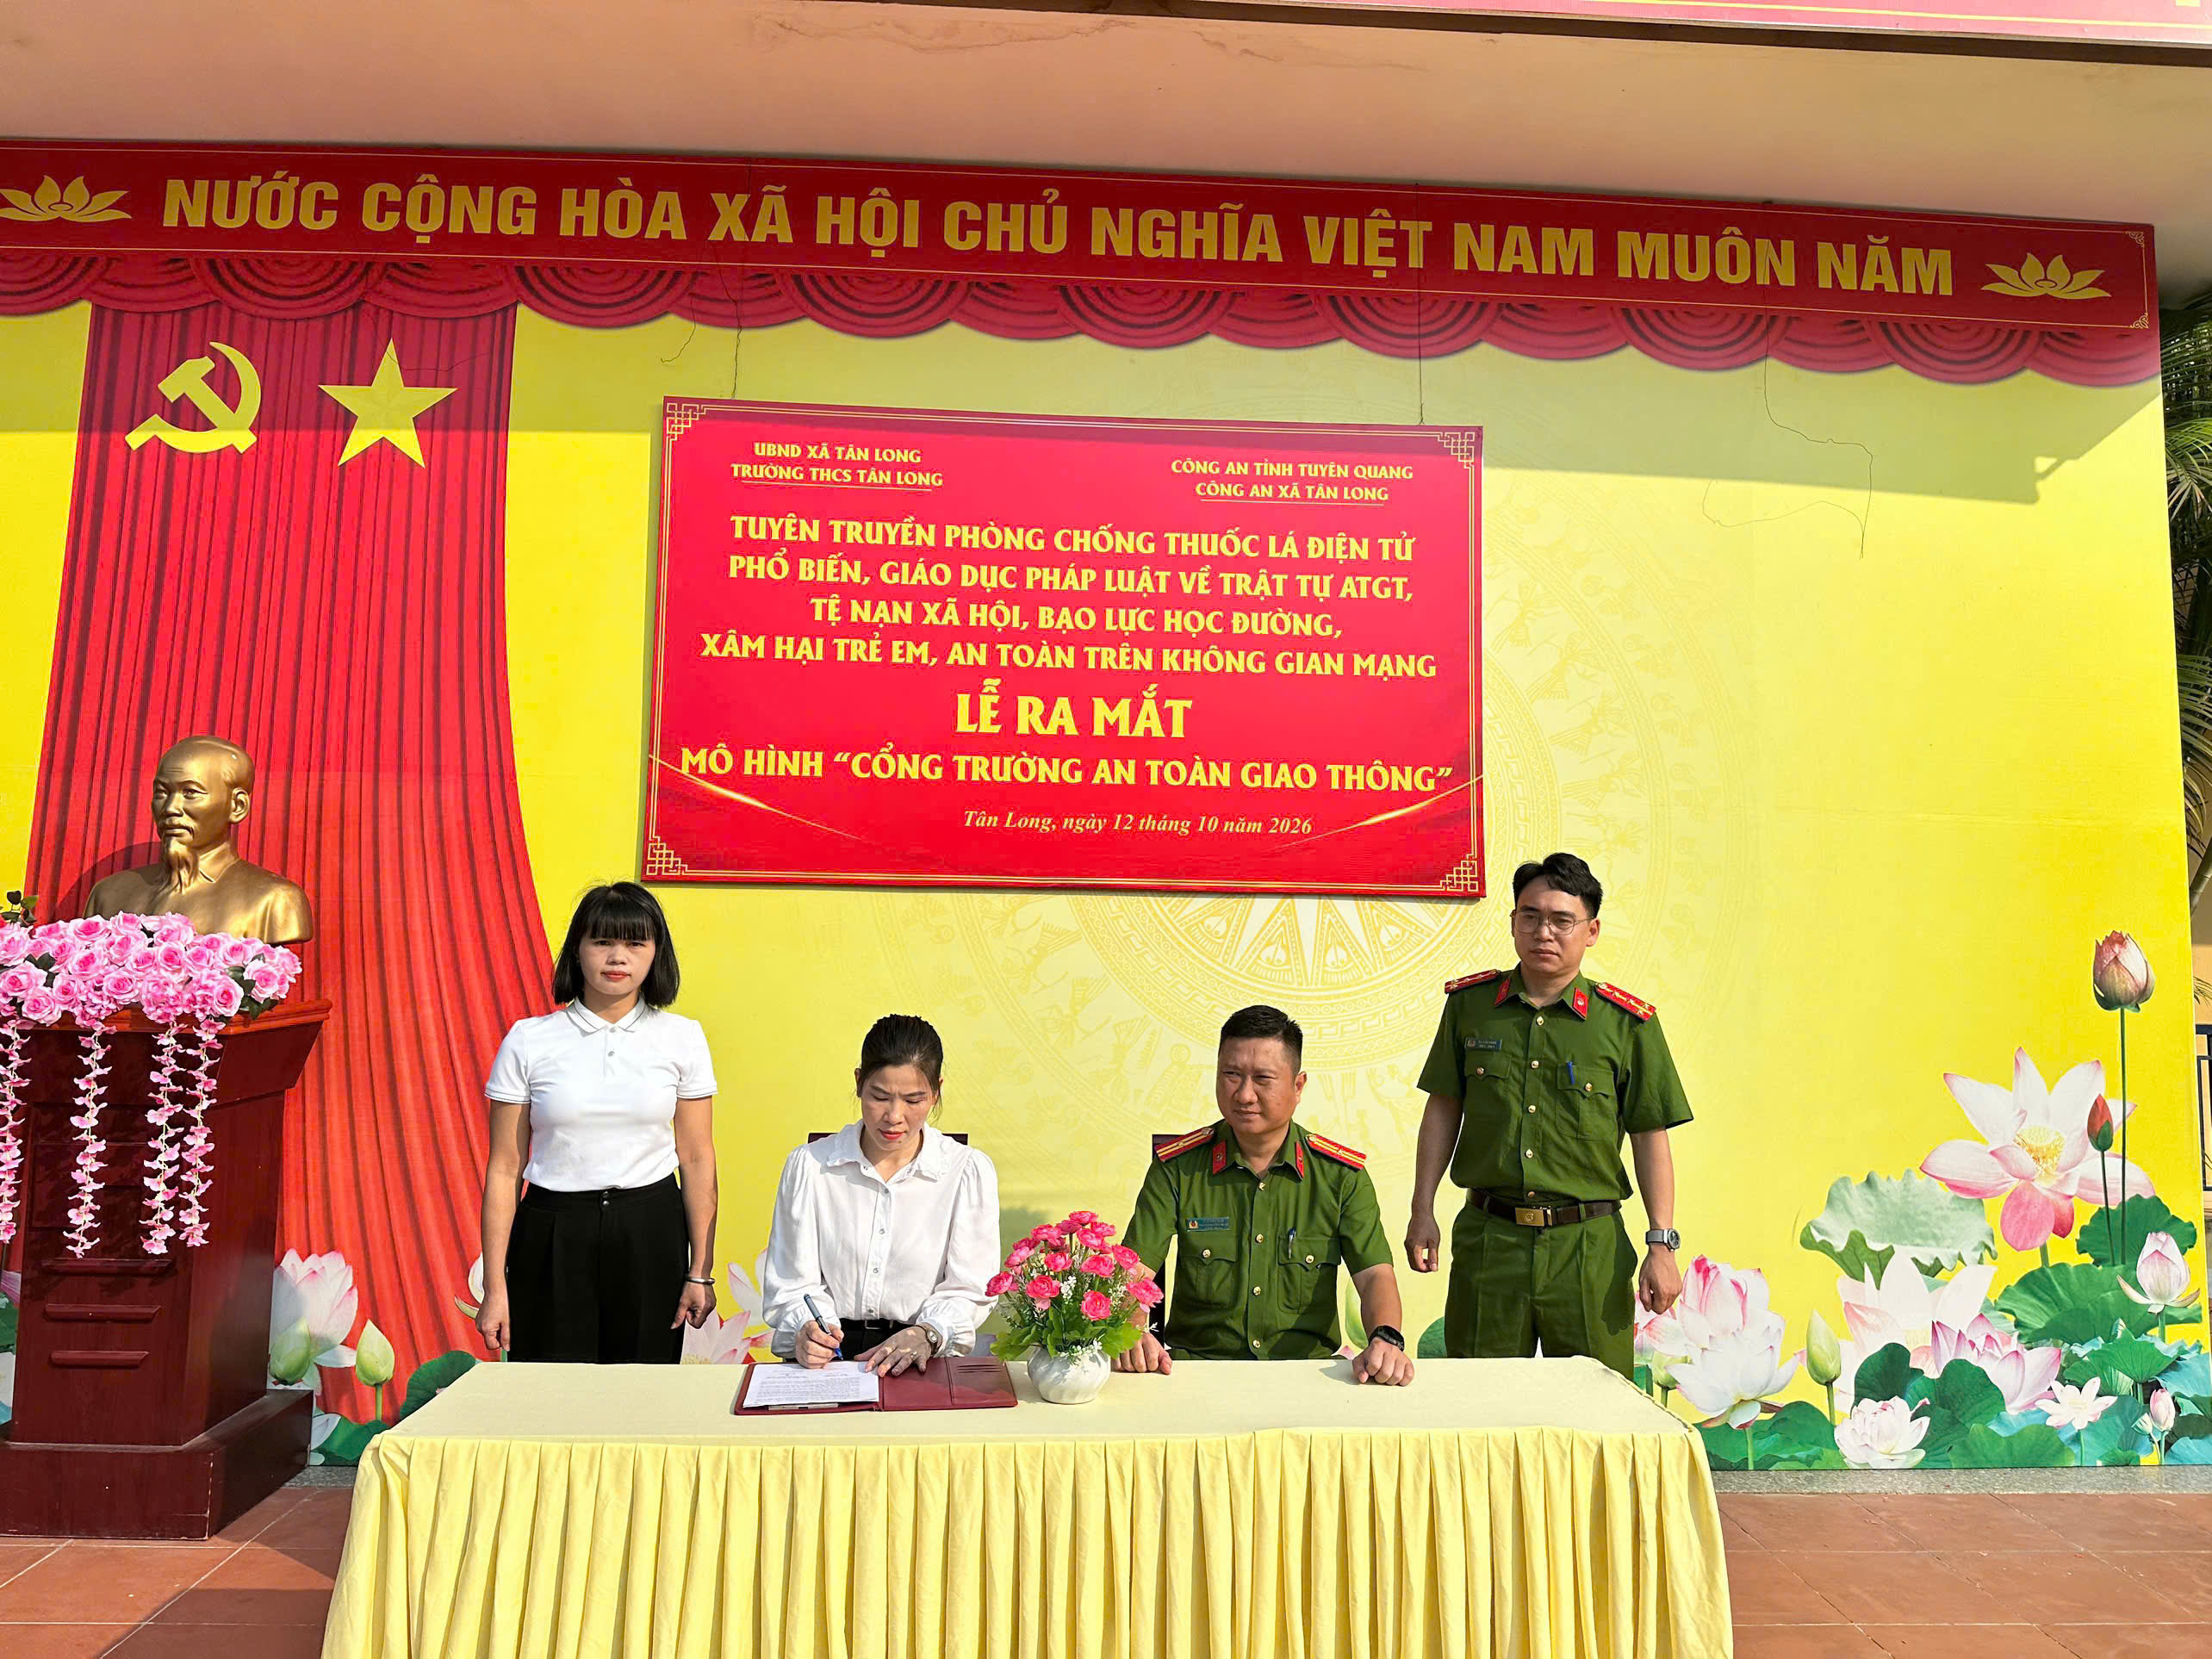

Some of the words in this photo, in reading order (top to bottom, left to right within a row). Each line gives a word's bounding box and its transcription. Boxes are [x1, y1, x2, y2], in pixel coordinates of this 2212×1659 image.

[164, 171, 338, 229] NƯỚC
[363, 175, 536, 243] CỘNG
[560, 178, 687, 239] HÒA
[708, 185, 792, 242] XÃ
[817, 188, 918, 258] HỘI
[944, 189, 1066, 253] CHỦ
[1091, 203, 1283, 262] NGHĨA
[1304, 209, 1432, 277] VIỆT
[1454, 223, 1593, 276] NAM
[1619, 227, 1795, 286] MUÔN
[1818, 236, 1952, 295] NĂM
[731, 463, 804, 480] TRƯỜNG
[810, 468, 852, 482] THCS
[857, 469, 891, 484] TÂN
[896, 471, 942, 486] LONG
[755, 443, 801, 457] UBND
[807, 443, 830, 459] XÃ
[835, 444, 868, 461] TÂN
[875, 449, 921, 463] LONG
[1171, 458, 1220, 474] CÔNG
[1225, 462, 1248, 475] AN
[1254, 458, 1292, 475] TỈNH
[1298, 462, 1349, 477] TUYÊN
[1354, 465, 1413, 480] QUANG
[1196, 481, 1245, 497] CÔNG
[1250, 484, 1272, 498] AN
[1278, 483, 1301, 498] XÃ
[1306, 483, 1338, 500] TÂN
[1343, 487, 1389, 501] LONG
[730, 513, 820, 541] TUYÊN
[829, 516, 935, 546] TRUYỀN
[945, 521, 1044, 550] PHÒNG
[1054, 524, 1155, 553] CHỐNG
[1165, 527, 1259, 556] THUỐC
[1268, 531, 1299, 558] LÁ
[1307, 532, 1369, 564] ĐIỆN
[1378, 531, 1416, 560] TỬ
[730, 548, 789, 579] PHỔ
[799, 552, 870, 585] BIẾN,
[880, 558, 951, 586] GIÁO
[961, 565, 1016, 593] DỤC
[1027, 563, 1096, 590] PHÁP
[1105, 565, 1171, 598] LUẬT
[1178, 565, 1211, 594] VỀ
[1219, 569, 1288, 600] TRẬT
[1296, 574, 1333, 602] TỰ
[1339, 576, 1413, 601] ATGT,
[811, 594, 841, 626] TỆ
[851, 600, 912, 627] NẠN
[922, 598, 960, 625] XÃ
[969, 600, 1028, 632] HỘI,
[1039, 606, 1096, 634] BẠO
[1106, 608, 1154, 636] LỰC
[1165, 610, 1223, 637] HỌC
[1231, 608, 1342, 638] ĐƯỜNG,
[701, 630, 765, 658] XÂM
[775, 637, 823, 665] HẠI
[833, 632, 882, 662] TRẺ
[892, 641, 937, 666] EM,
[946, 643, 987, 665] AN
[996, 641, 1075, 668] TOÀN
[1084, 643, 1153, 670] TRÊN
[1162, 645, 1265, 673] KHÔNG
[1275, 652, 1344, 675] GIAN
[1353, 654, 1436, 681] MẠNG
[956, 679, 1001, 733] LỄ
[1016, 696, 1078, 735] RA
[1092, 684, 1192, 737] MẮT
[681, 743, 734, 774] MÔ
[744, 744, 823, 777] HÌNH
[834, 743, 942, 780] “CỔNG
[953, 751, 1082, 783] TRƯỜNG
[1092, 760, 1135, 784] AN
[1146, 755, 1230, 786] TOÀN
[1241, 762, 1316, 788] GIAO
[1327, 760, 1452, 791] THÔNG”
[966, 811, 997, 827] Tân
[1006, 812, 1055, 832] Long,
[1063, 814, 1106, 833] ngày
[1114, 815, 1134, 830] 12
[1139, 815, 1190, 835] tháng
[1199, 817, 1218, 831] 10
[1224, 818, 1261, 833] năm
[1269, 818, 1311, 834] 2026
